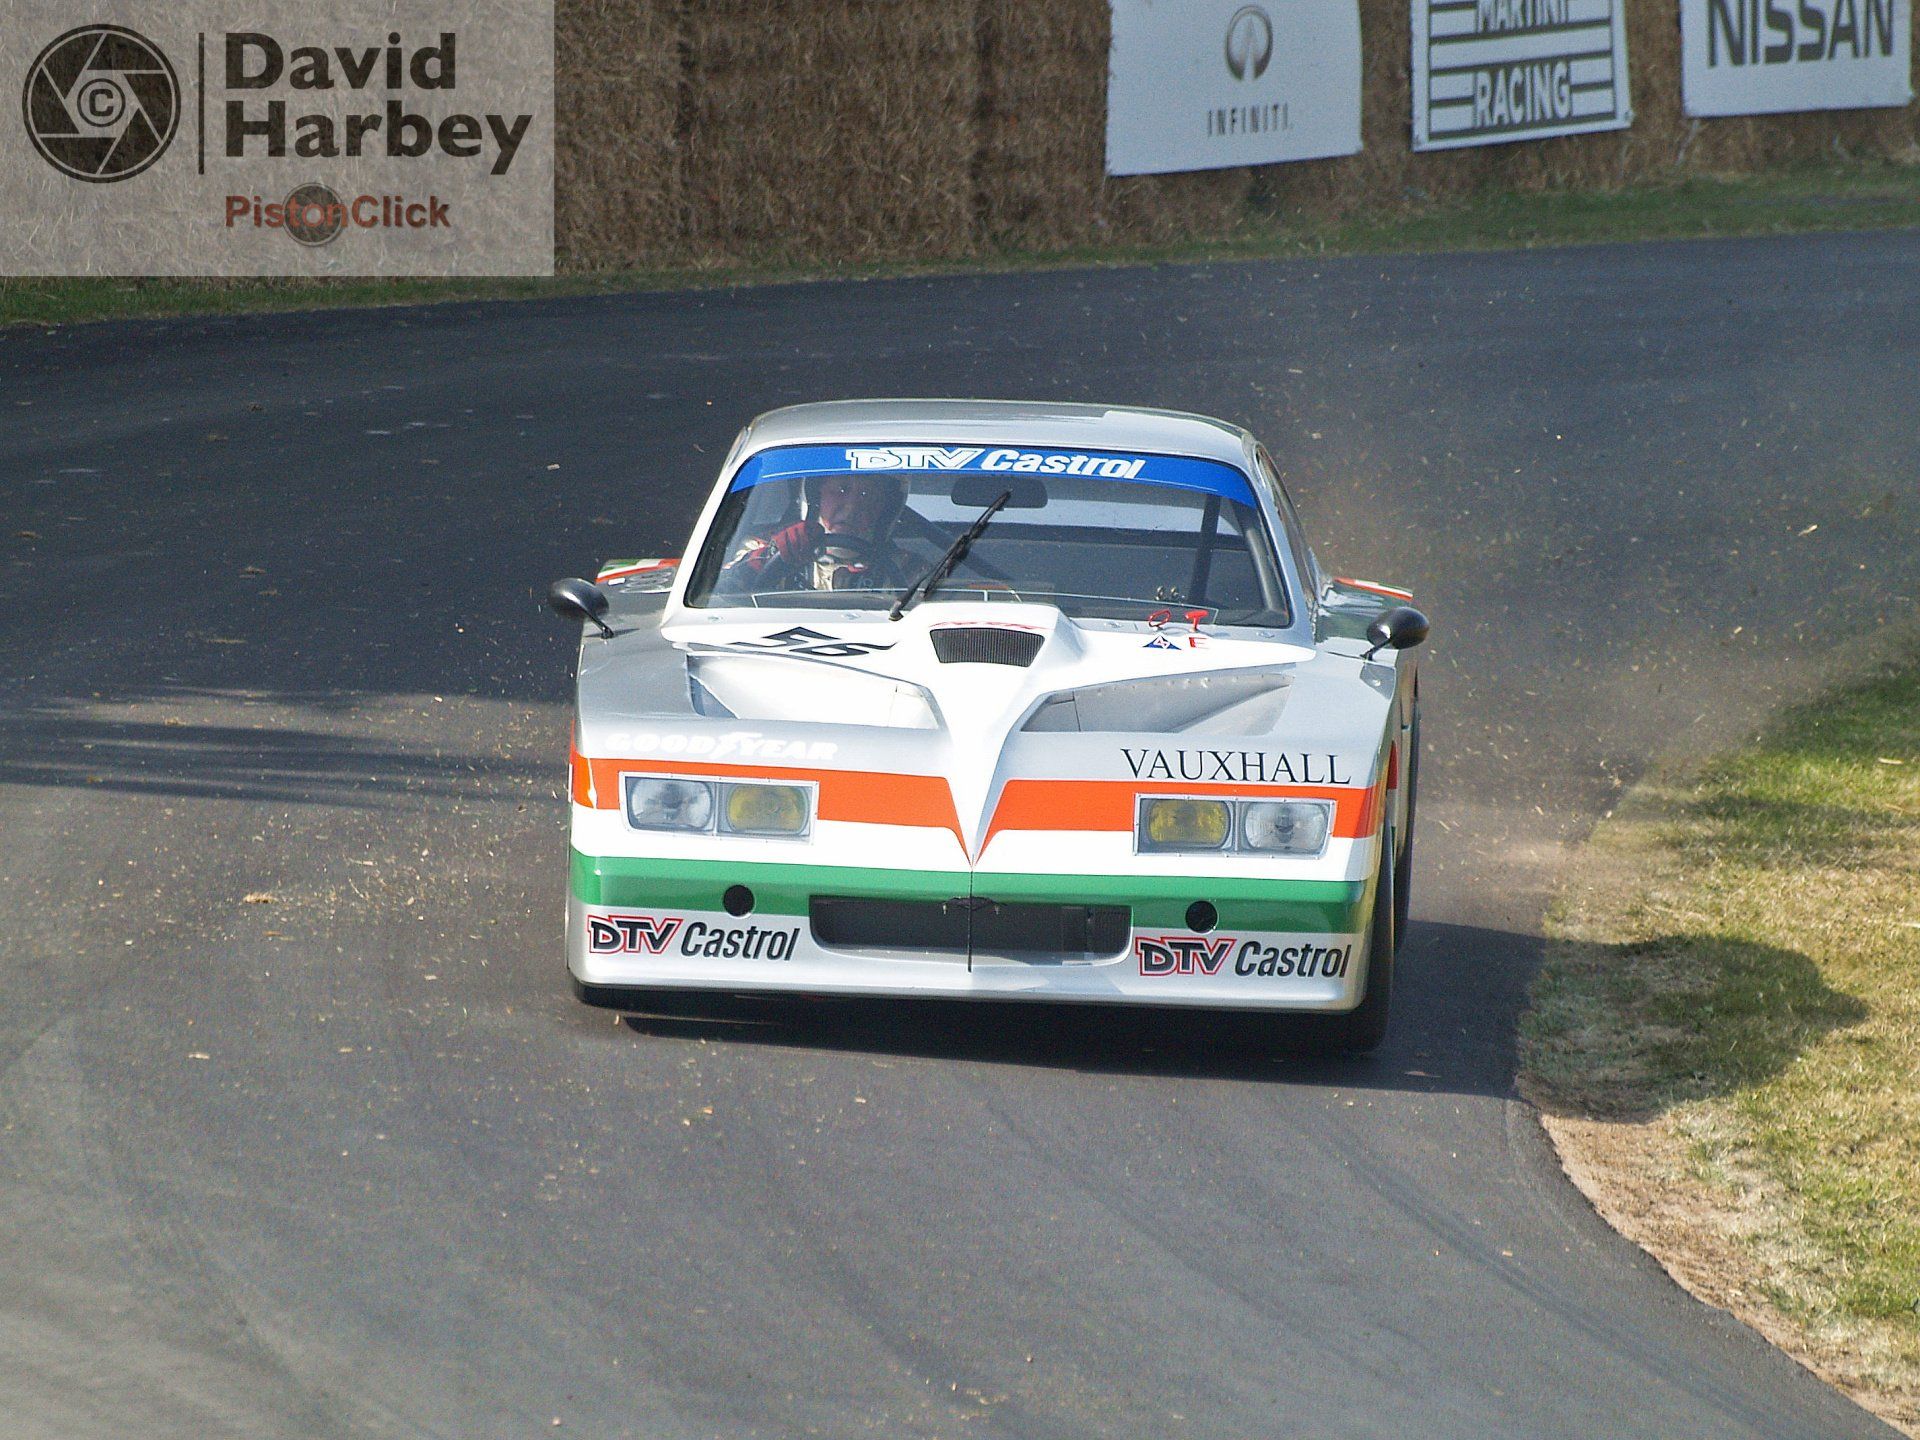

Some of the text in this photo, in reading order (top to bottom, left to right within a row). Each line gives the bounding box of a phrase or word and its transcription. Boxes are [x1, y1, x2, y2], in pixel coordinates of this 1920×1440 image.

[1707, 0, 1893, 68] NISSAN
[1476, 60, 1571, 128] RACING
[1207, 102, 1289, 137] INFINITI
[846, 447, 1146, 479] DTV Castrol
[1120, 748, 1351, 785] VAUXHALL
[587, 914, 800, 961] DTV Castrol
[1135, 936, 1352, 978] DTV Castrol
